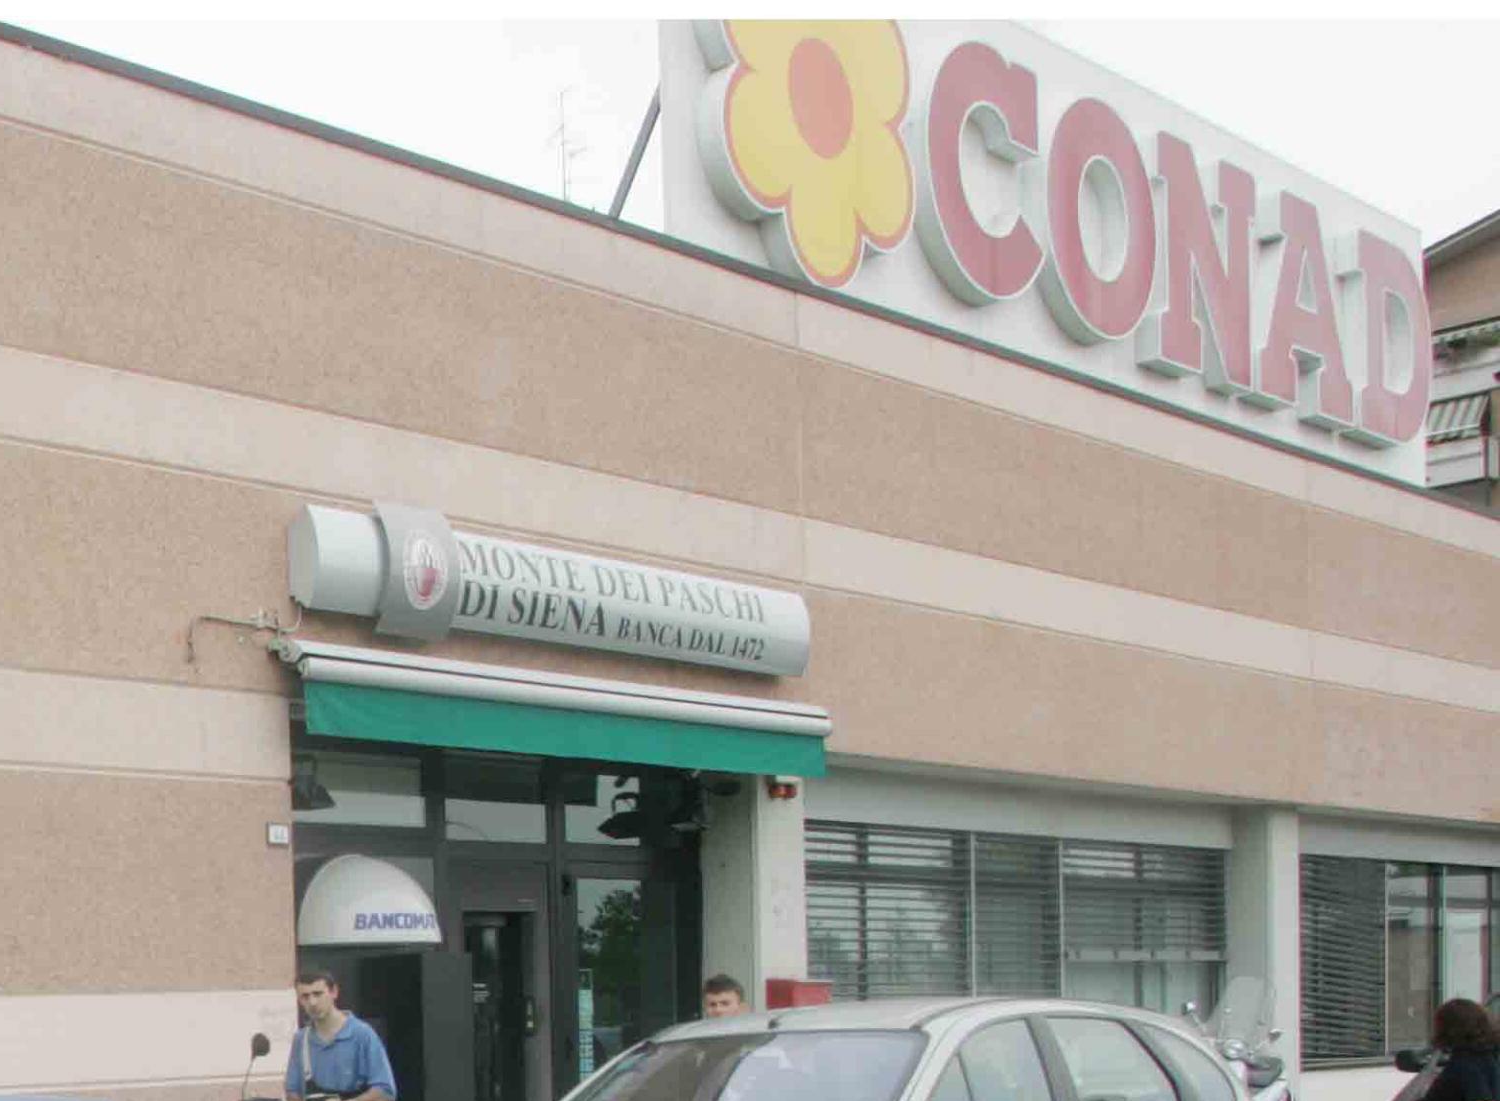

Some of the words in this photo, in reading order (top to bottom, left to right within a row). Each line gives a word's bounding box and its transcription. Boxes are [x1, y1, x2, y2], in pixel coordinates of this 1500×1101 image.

[927, 40, 1431, 444] CONAD
[456, 540, 584, 592] MONTE
[592, 564, 651, 603] DEI
[657, 575, 765, 623] PASCHI
[457, 580, 499, 619] DI
[507, 588, 605, 636] SIENA
[617, 617, 682, 649] BANCA
[689, 629, 726, 655] DAL
[732, 636, 765, 660] 1472
